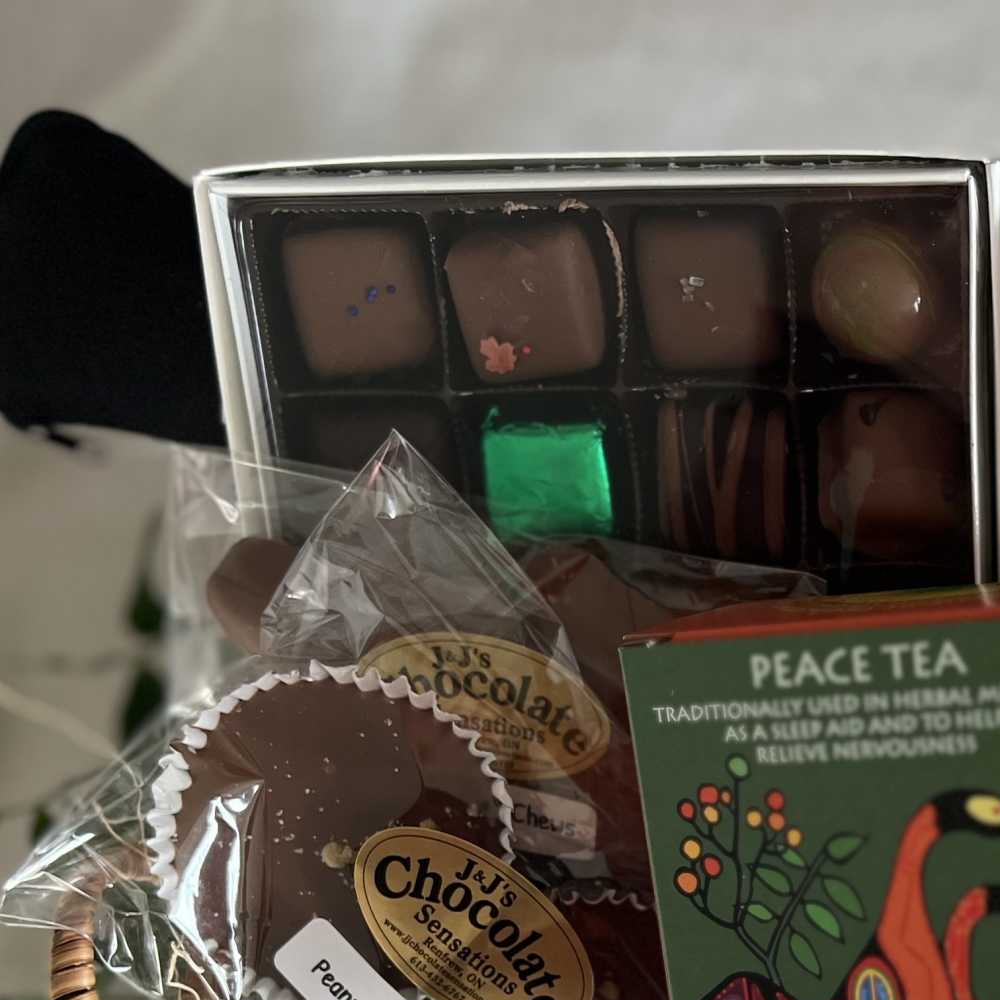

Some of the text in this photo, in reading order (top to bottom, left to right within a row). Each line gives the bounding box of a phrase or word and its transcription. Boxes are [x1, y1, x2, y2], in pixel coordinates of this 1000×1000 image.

[750, 639, 969, 690] PEACE TEA
[382, 667, 588, 756] hocolate
[652, 699, 803, 723] TRADITIONALLY
[806, 694, 861, 716] USED
[863, 692, 890, 712] IN
[892, 685, 973, 711] HERBAL
[724, 724, 749, 743] AS
[751, 724, 769, 742] A
[769, 718, 823, 741] SLEEP
[825, 713, 866, 738] AID
[868, 711, 918, 735] AND
[920, 708, 953, 731] TO
[755, 733, 978, 764] RELIEVE NERVOUSNESS
[455, 857, 518, 909] J&J's
[413, 903, 518, 996] Sensations
[423, 936, 487, 989] Renfrew, ON
